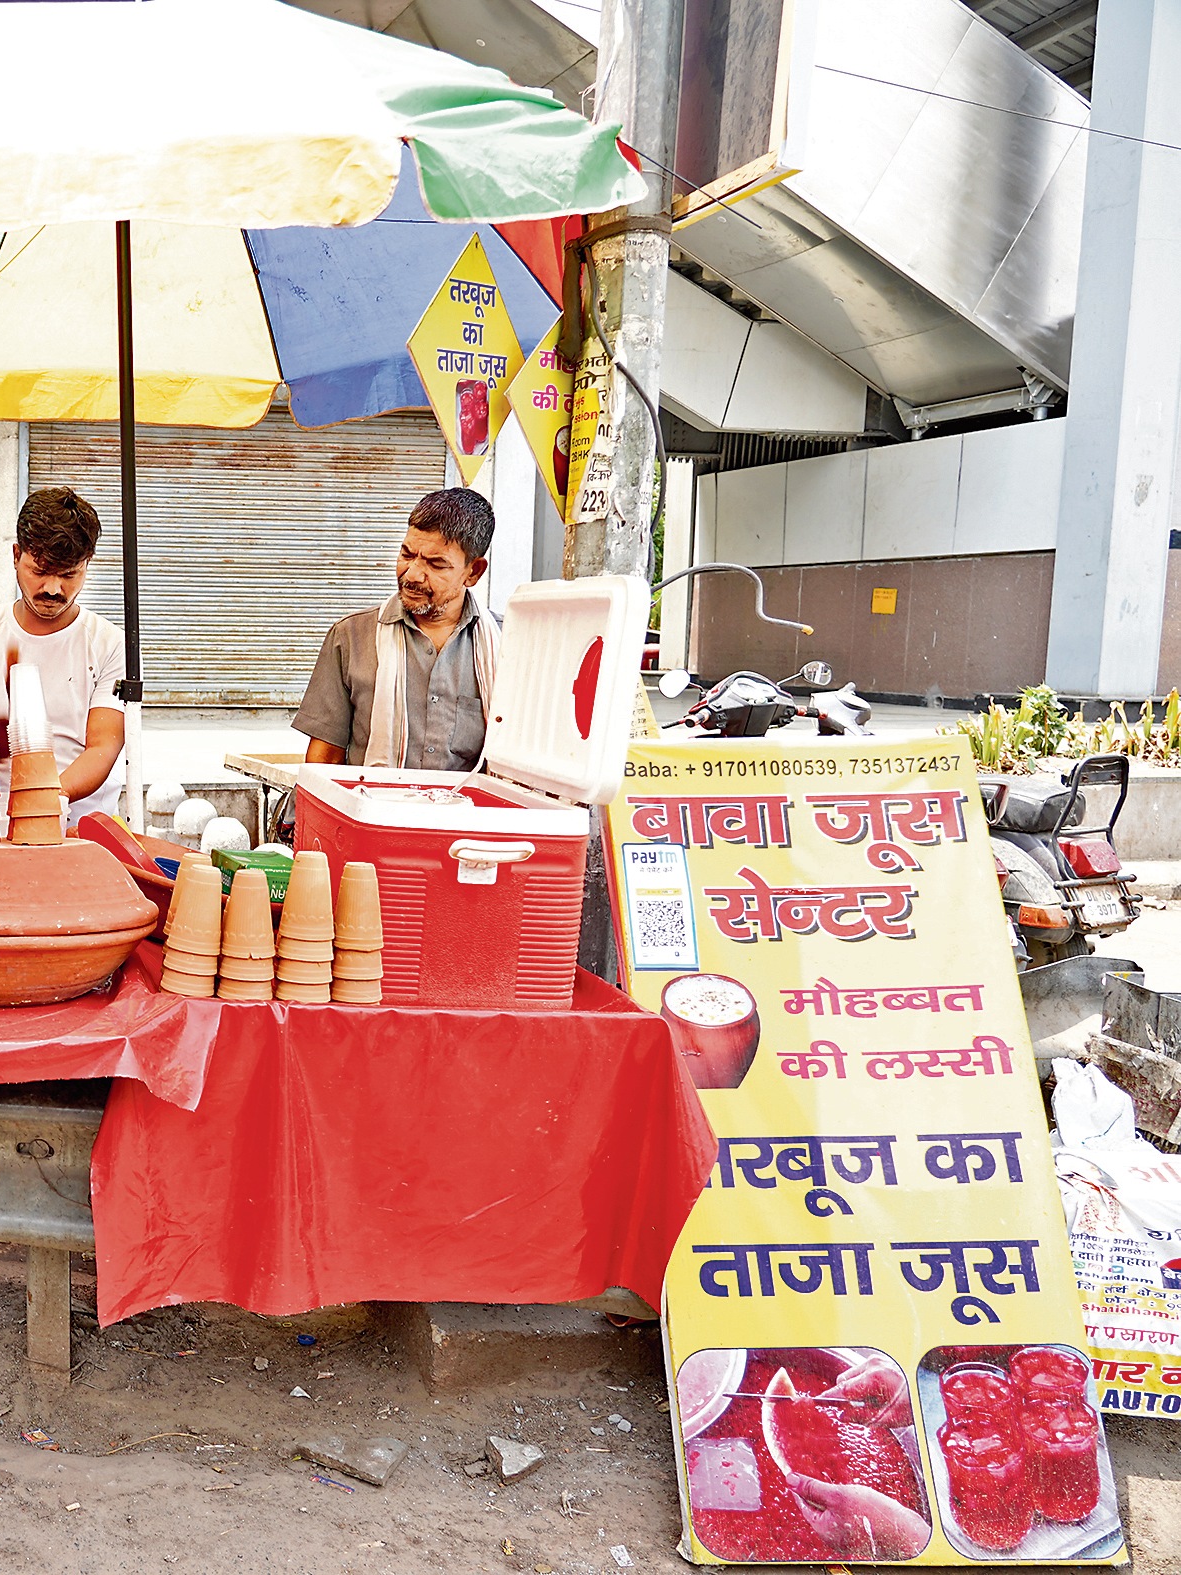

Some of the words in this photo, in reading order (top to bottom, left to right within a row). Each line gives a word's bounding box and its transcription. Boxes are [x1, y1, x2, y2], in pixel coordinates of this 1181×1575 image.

[449, 278, 496, 317] तरबूज
[462, 322, 483, 346] का
[437, 349, 474, 375] ताजा
[478, 355, 507, 390] जूस
[532, 384, 559, 411] की
[624, 761, 678, 778] Baba:
[702, 759, 844, 778] 917011080539,
[848, 755, 961, 775] 7351372437
[804, 790, 969, 874] जूस
[631, 850, 678, 864] paytm
[704, 866, 918, 942] सेन्टर
[780, 976, 985, 1019] मौहब्बत
[776, 1039, 848, 1081] की
[861, 1035, 1014, 1080] लस्सी
[916, 1131, 1023, 1184] का
[691, 1242, 875, 1298] ताजा
[890, 1239, 1041, 1326] जूस
